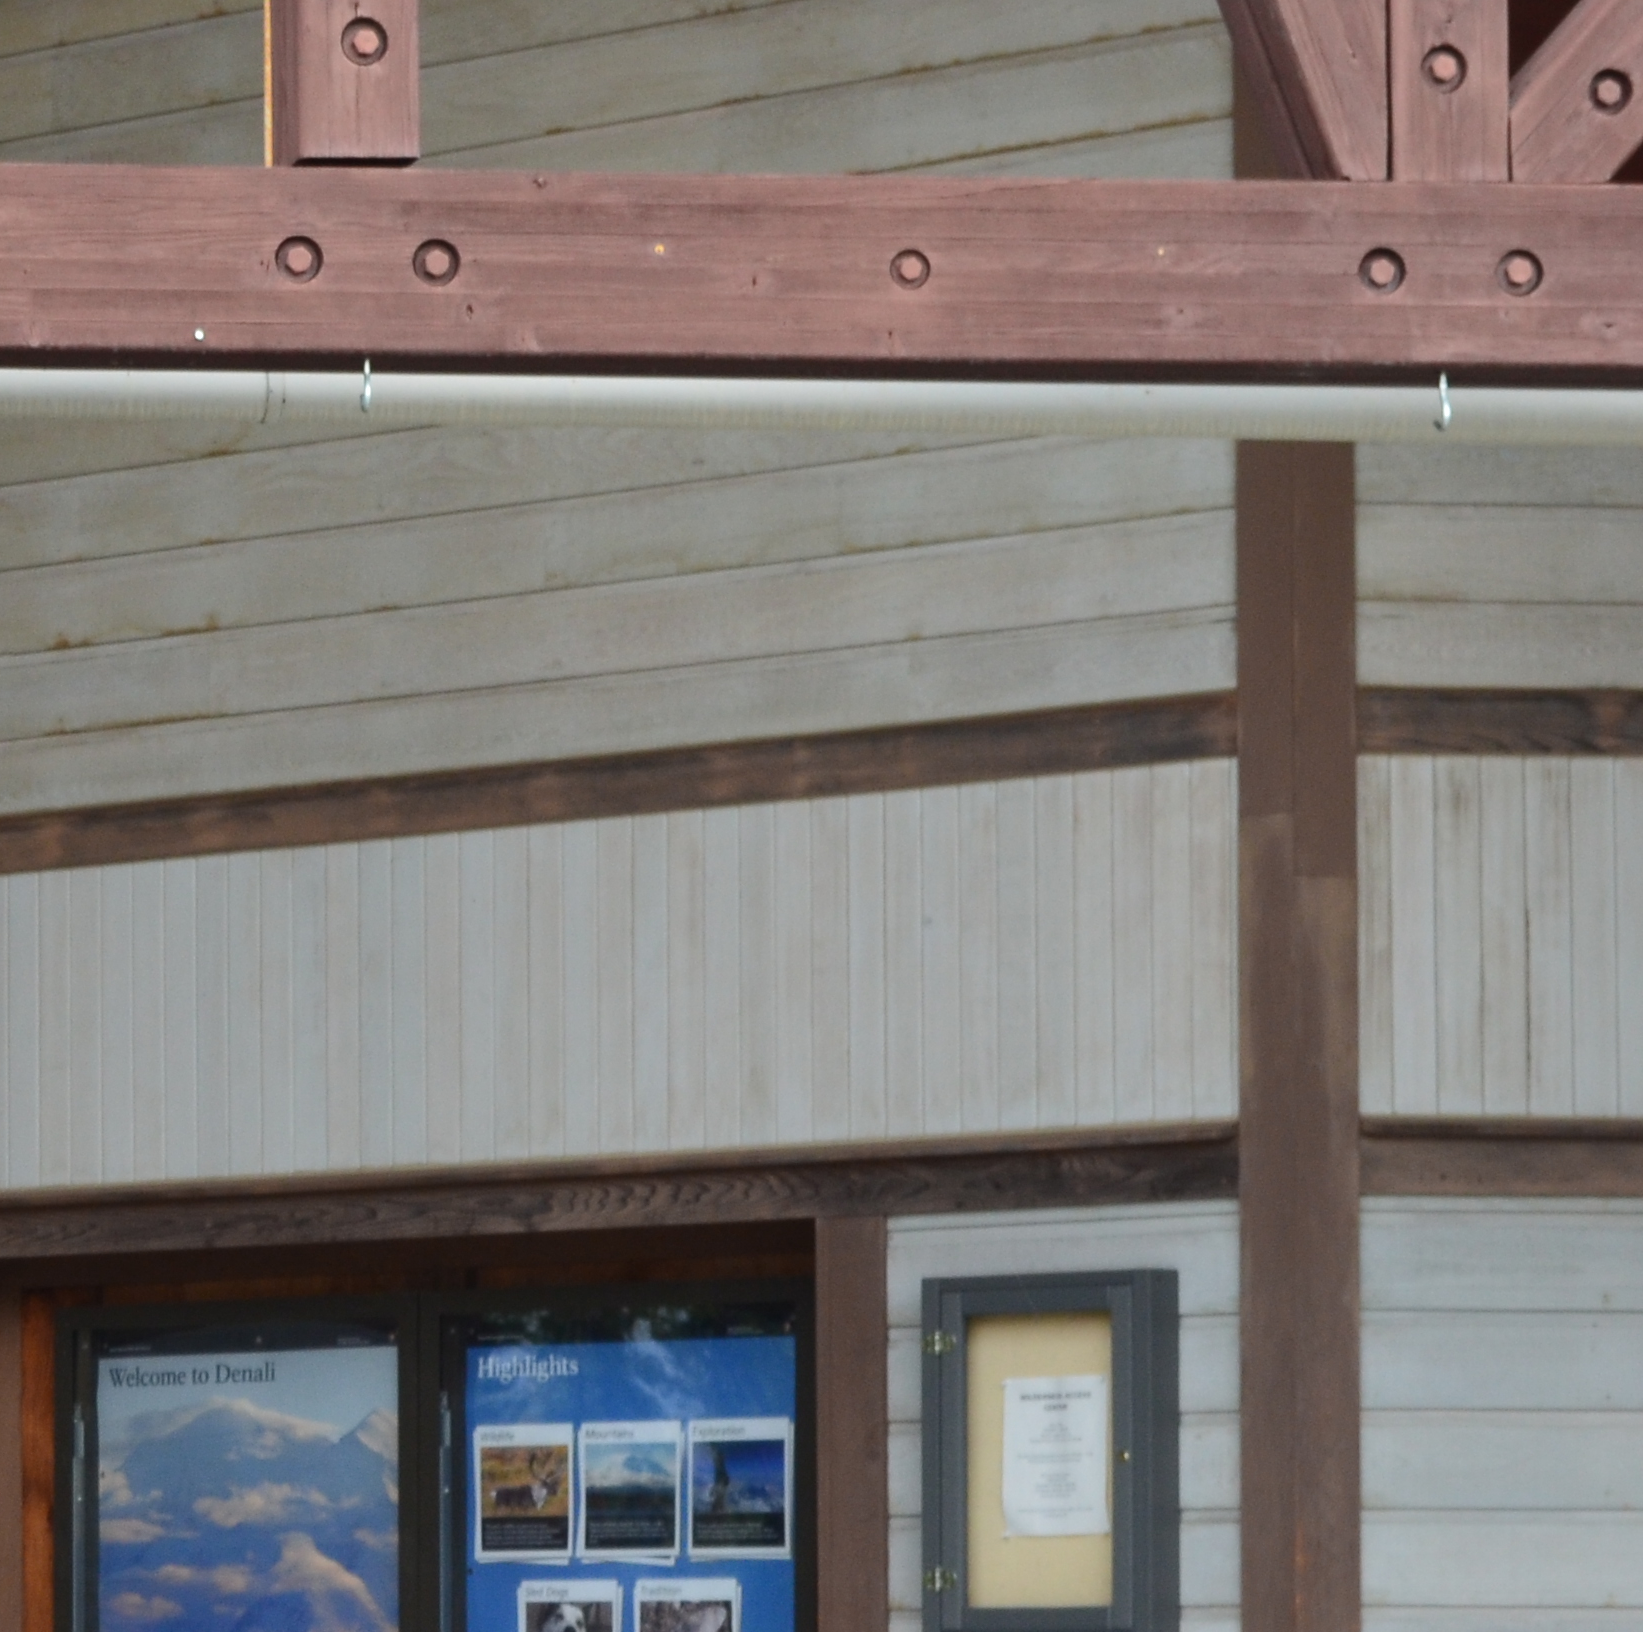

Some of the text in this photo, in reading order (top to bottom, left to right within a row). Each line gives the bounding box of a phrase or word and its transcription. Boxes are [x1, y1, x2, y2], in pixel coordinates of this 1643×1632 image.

[108, 1362, 277, 1388] Welcome to Denali
[477, 1353, 580, 1383] Highlights
